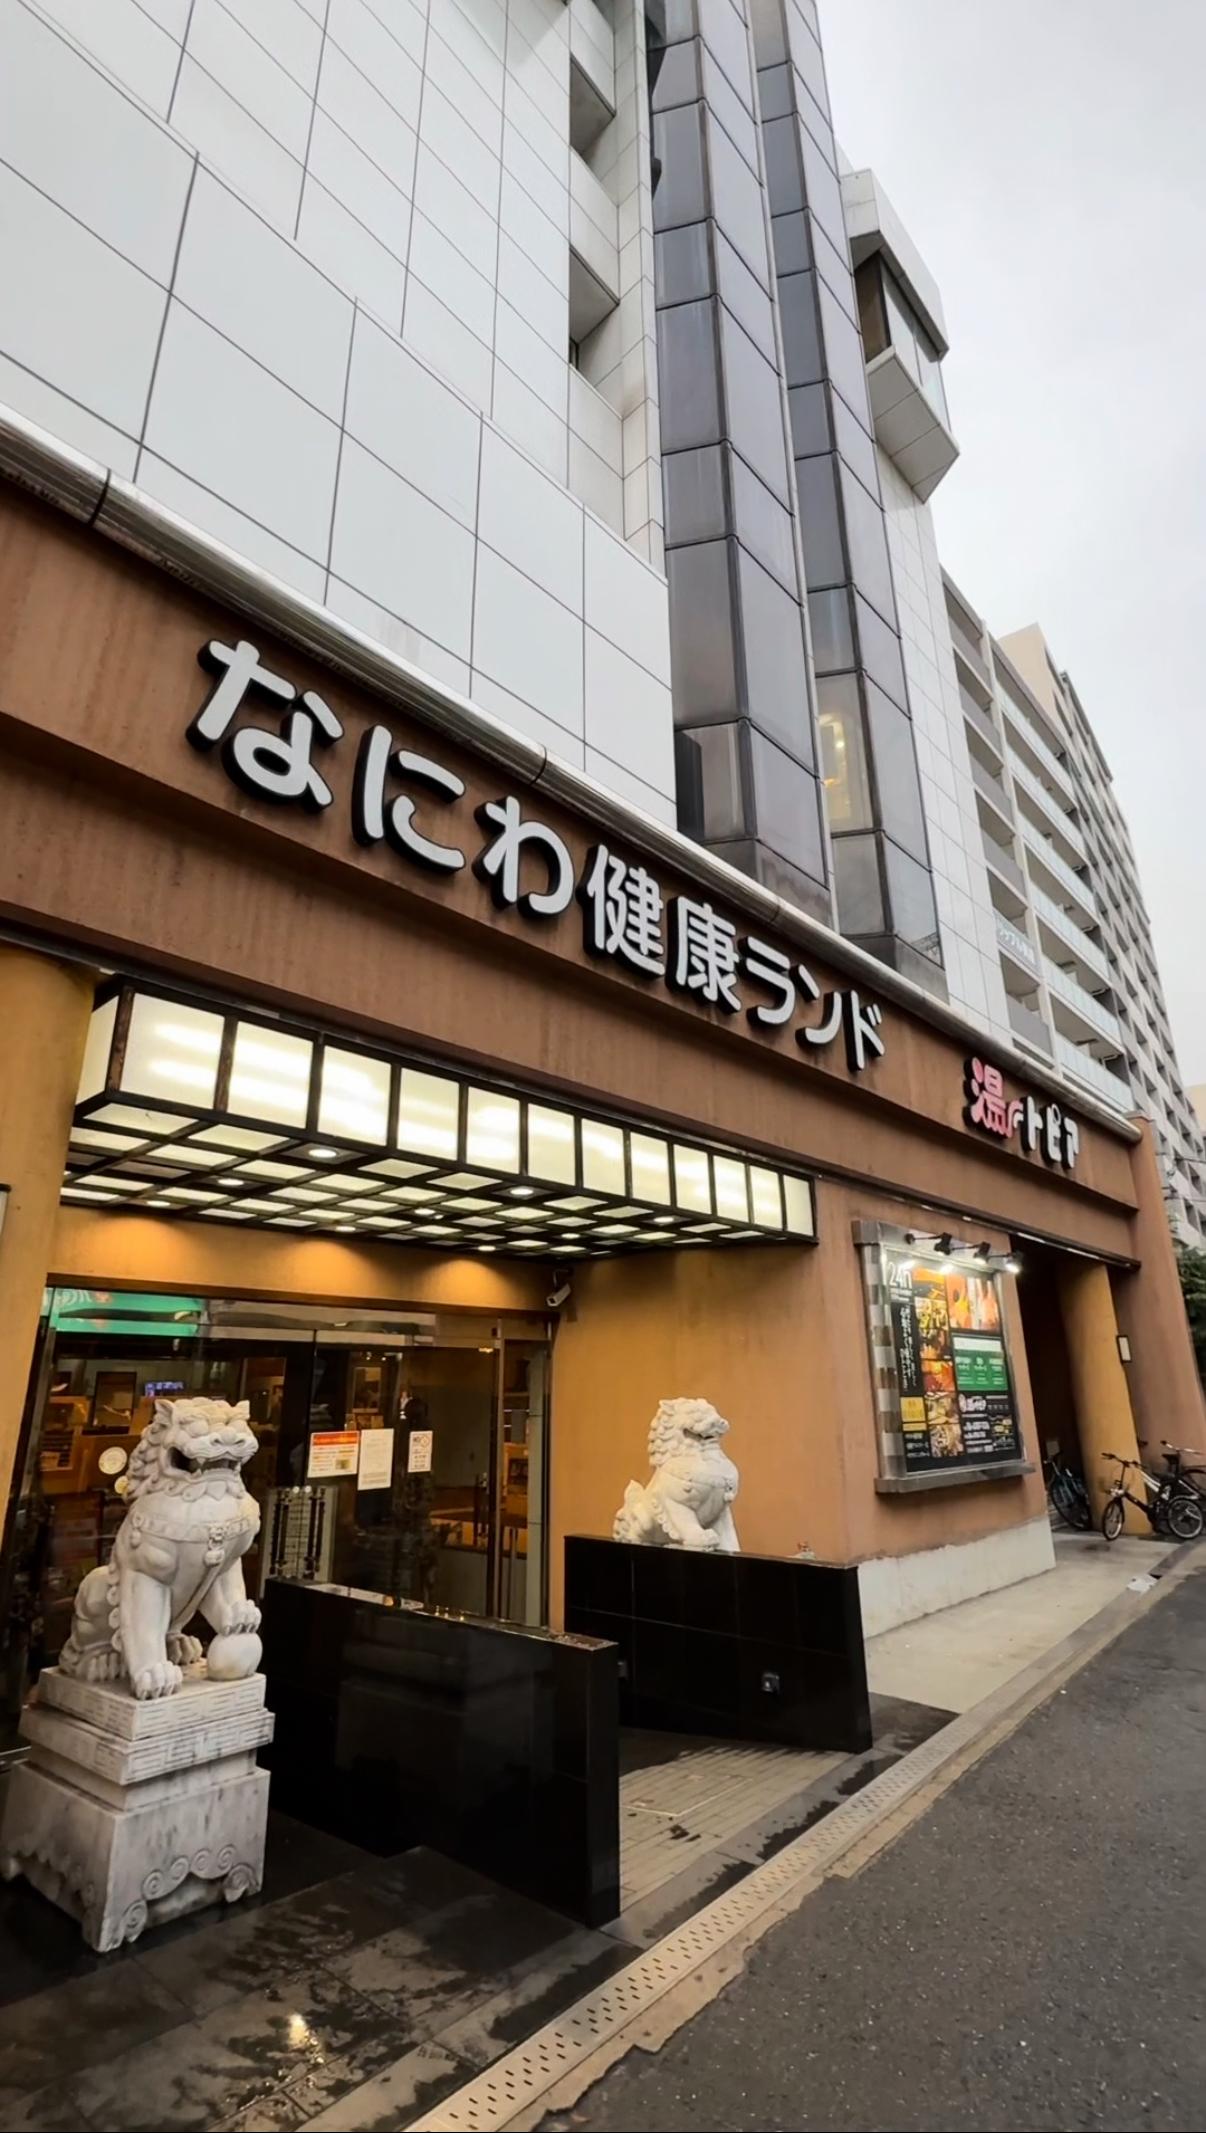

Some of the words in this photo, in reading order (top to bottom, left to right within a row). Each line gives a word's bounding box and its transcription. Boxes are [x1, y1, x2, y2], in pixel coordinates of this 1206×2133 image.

[194, 640, 886, 1071] なにわ健康ランド
